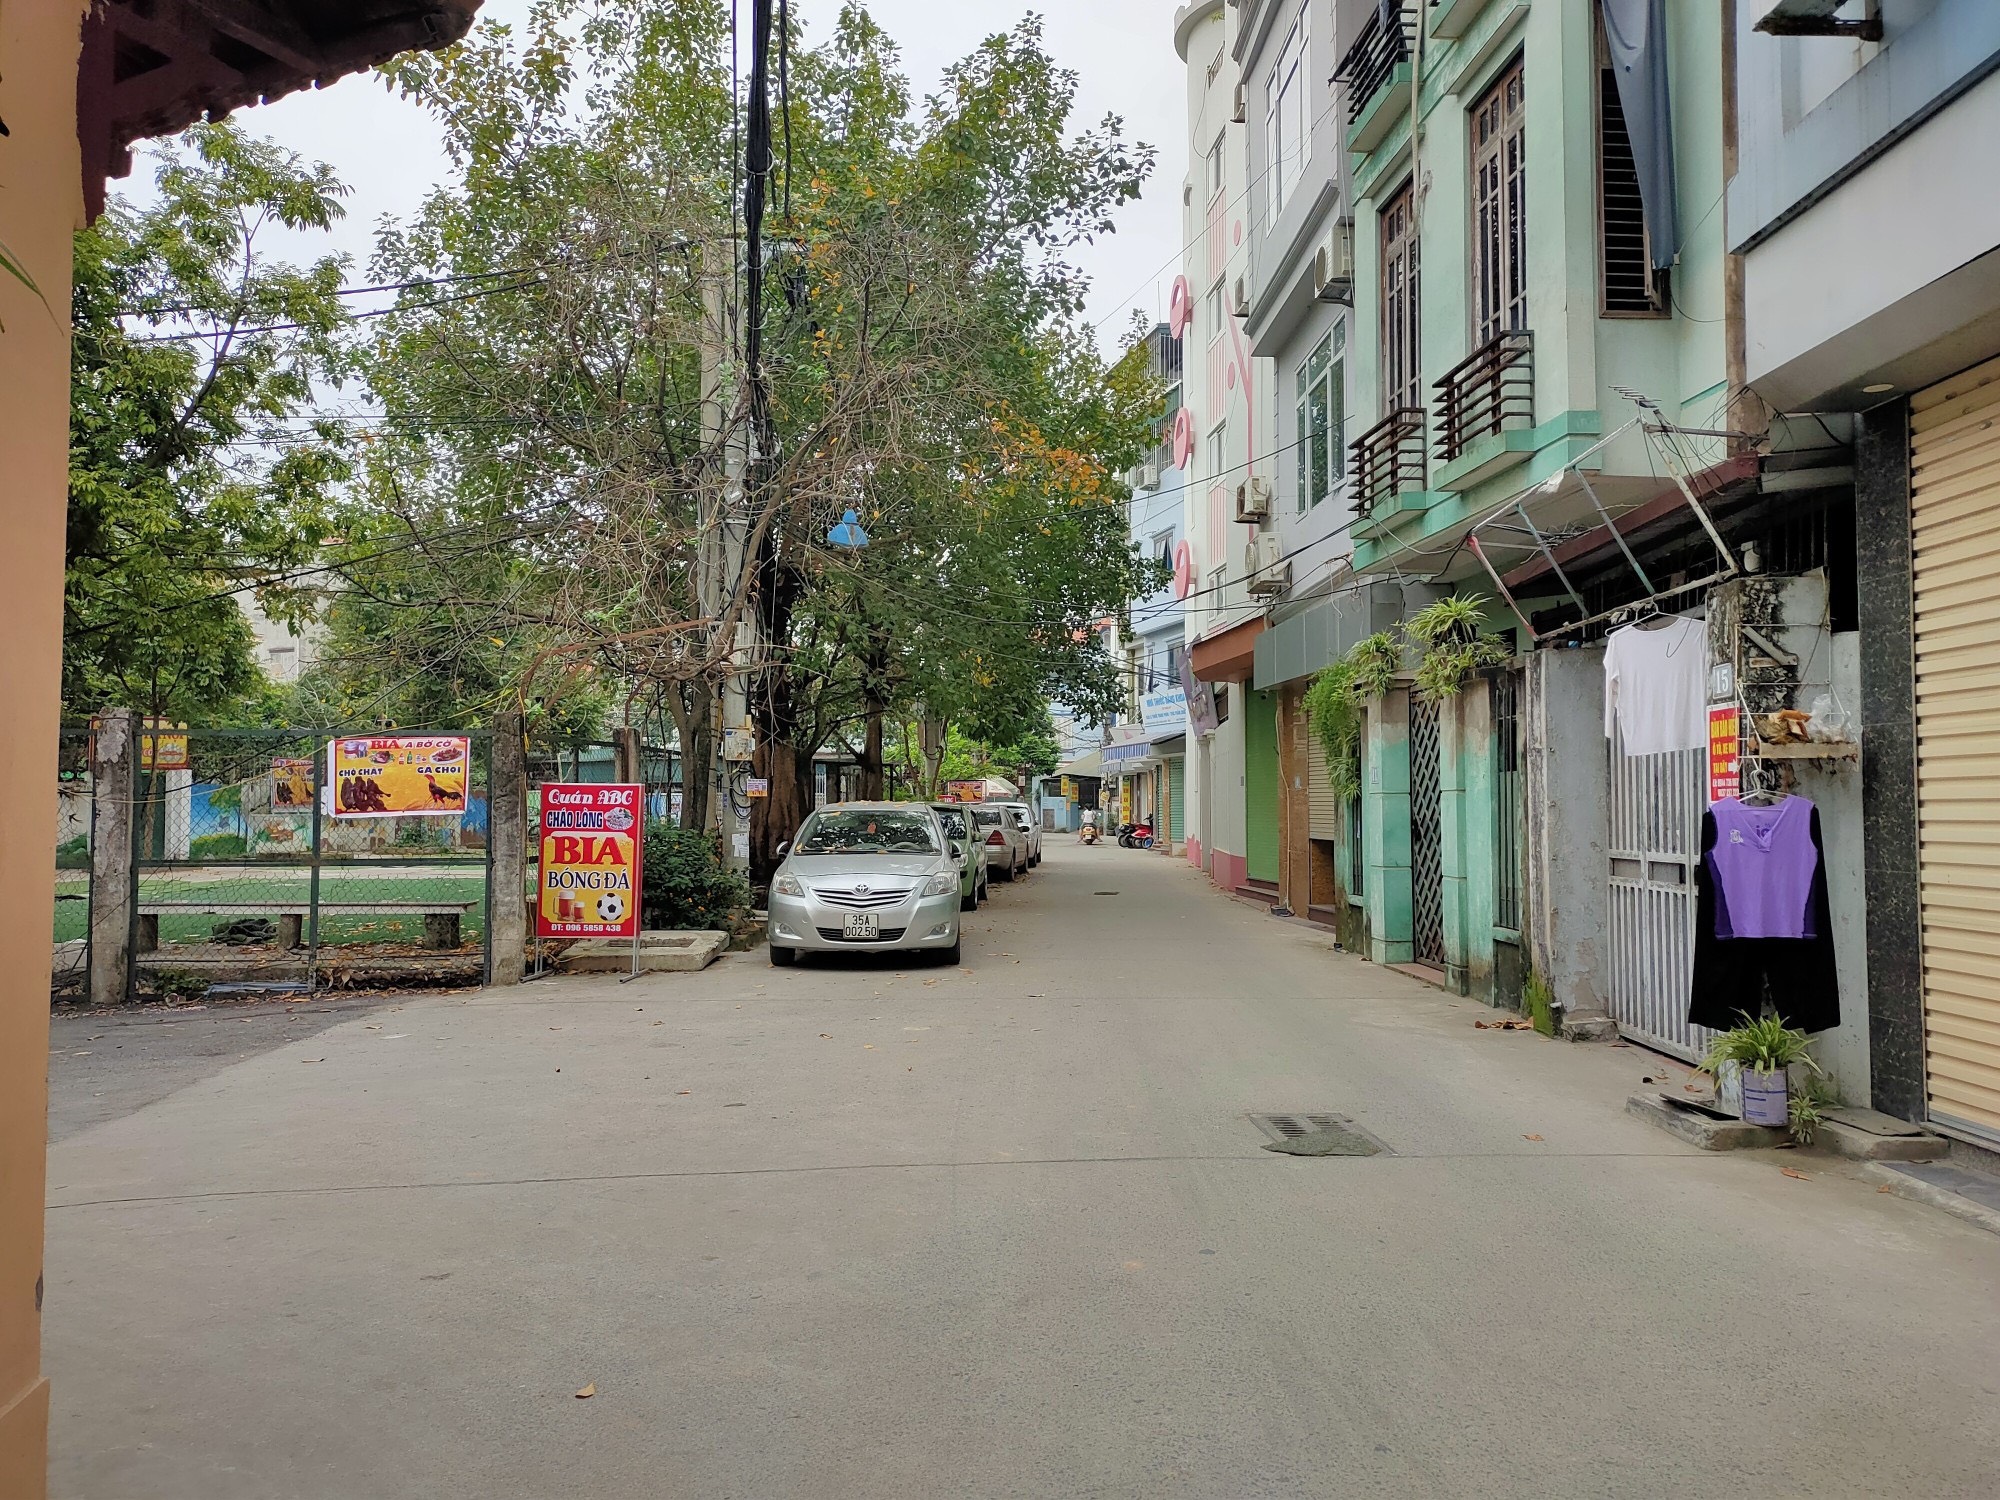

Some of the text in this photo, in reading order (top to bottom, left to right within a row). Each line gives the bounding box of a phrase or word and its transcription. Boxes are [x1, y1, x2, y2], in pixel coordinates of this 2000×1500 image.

[1716, 669, 1729, 694] 15
[370, 740, 400, 749] BIA
[417, 765, 433, 773] GÀ
[548, 789, 633, 805] Quán ABC
[547, 807, 603, 829] CHÁO LÒNG
[551, 836, 627, 865] BIA
[547, 867, 630, 890] BÓNG ĐÁ
[852, 915, 870, 925] 35A
[845, 926, 877, 937] 002.50
